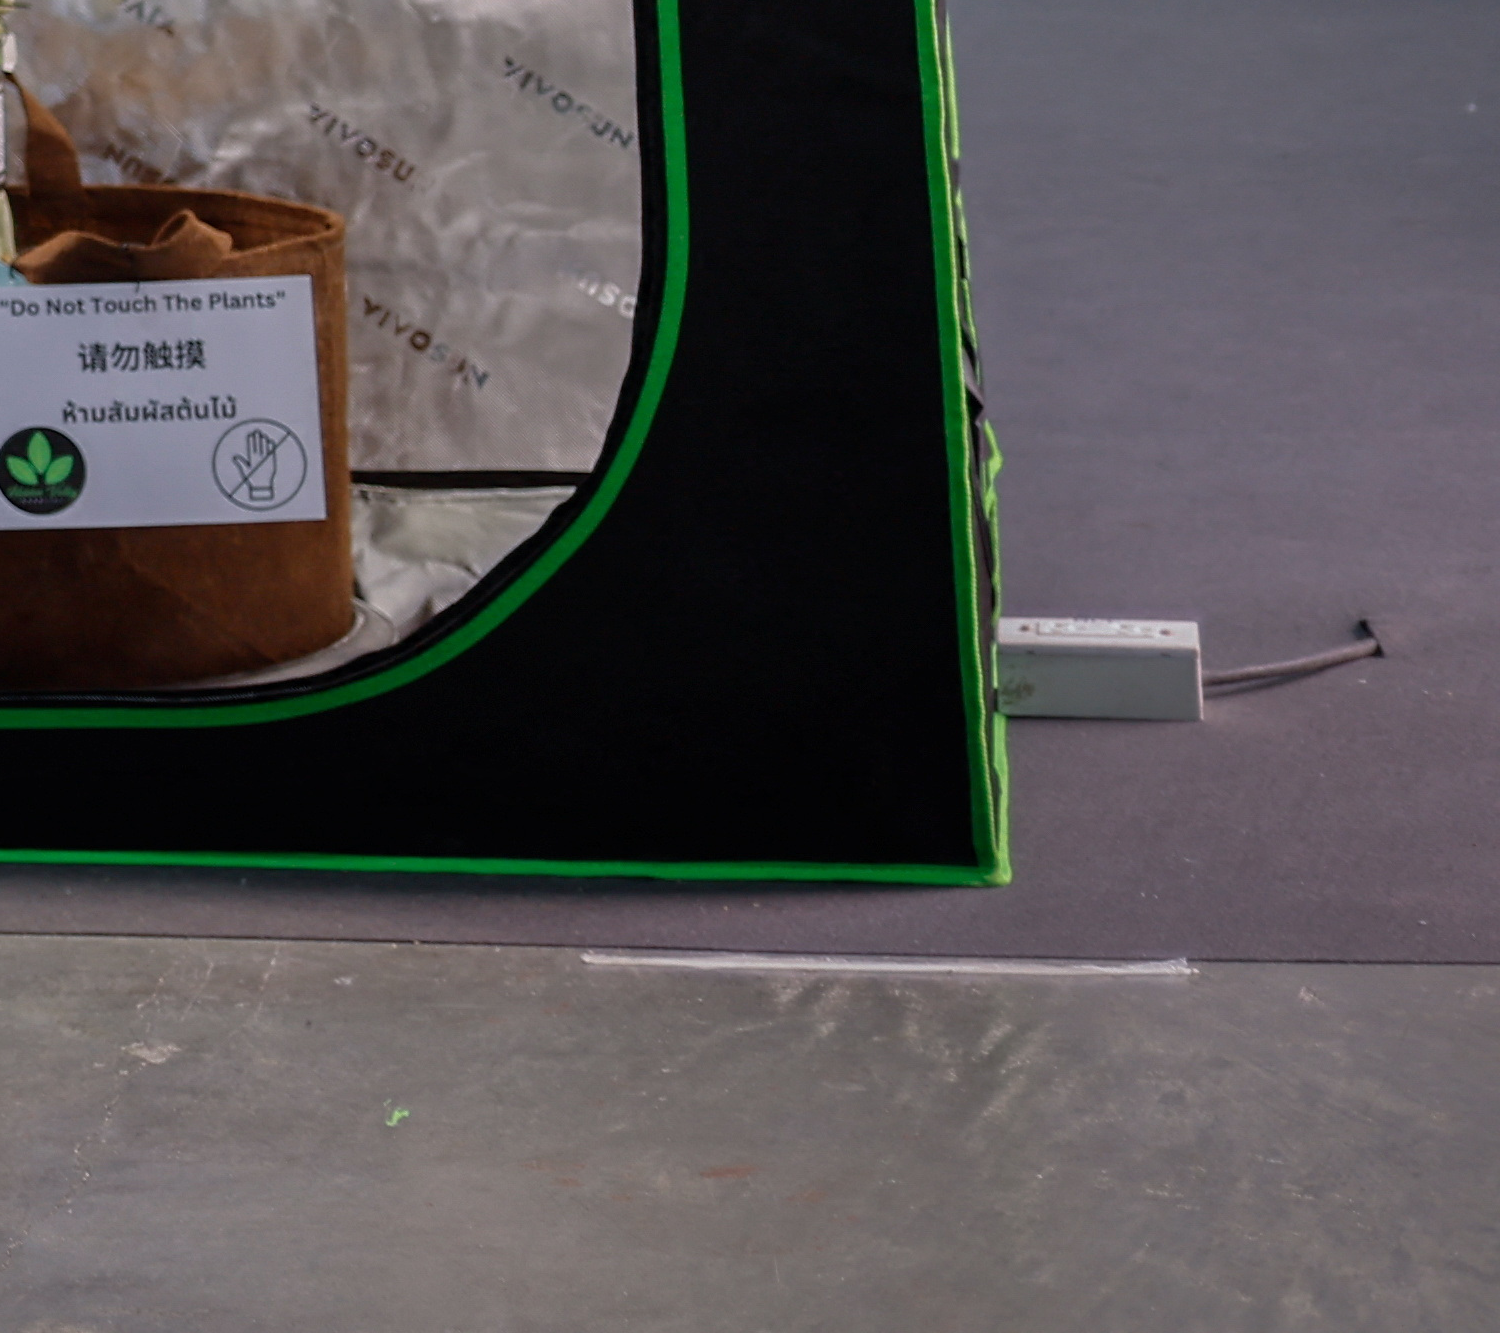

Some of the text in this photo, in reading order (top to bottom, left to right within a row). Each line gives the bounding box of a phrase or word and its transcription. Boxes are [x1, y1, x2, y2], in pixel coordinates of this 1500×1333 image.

[0, 290, 286, 318] "Do Not Touch The Plants"
[77, 338, 206, 373] 请勿触摸
[62, 394, 237, 425] ห้ามสัมผัสต้นไม้
